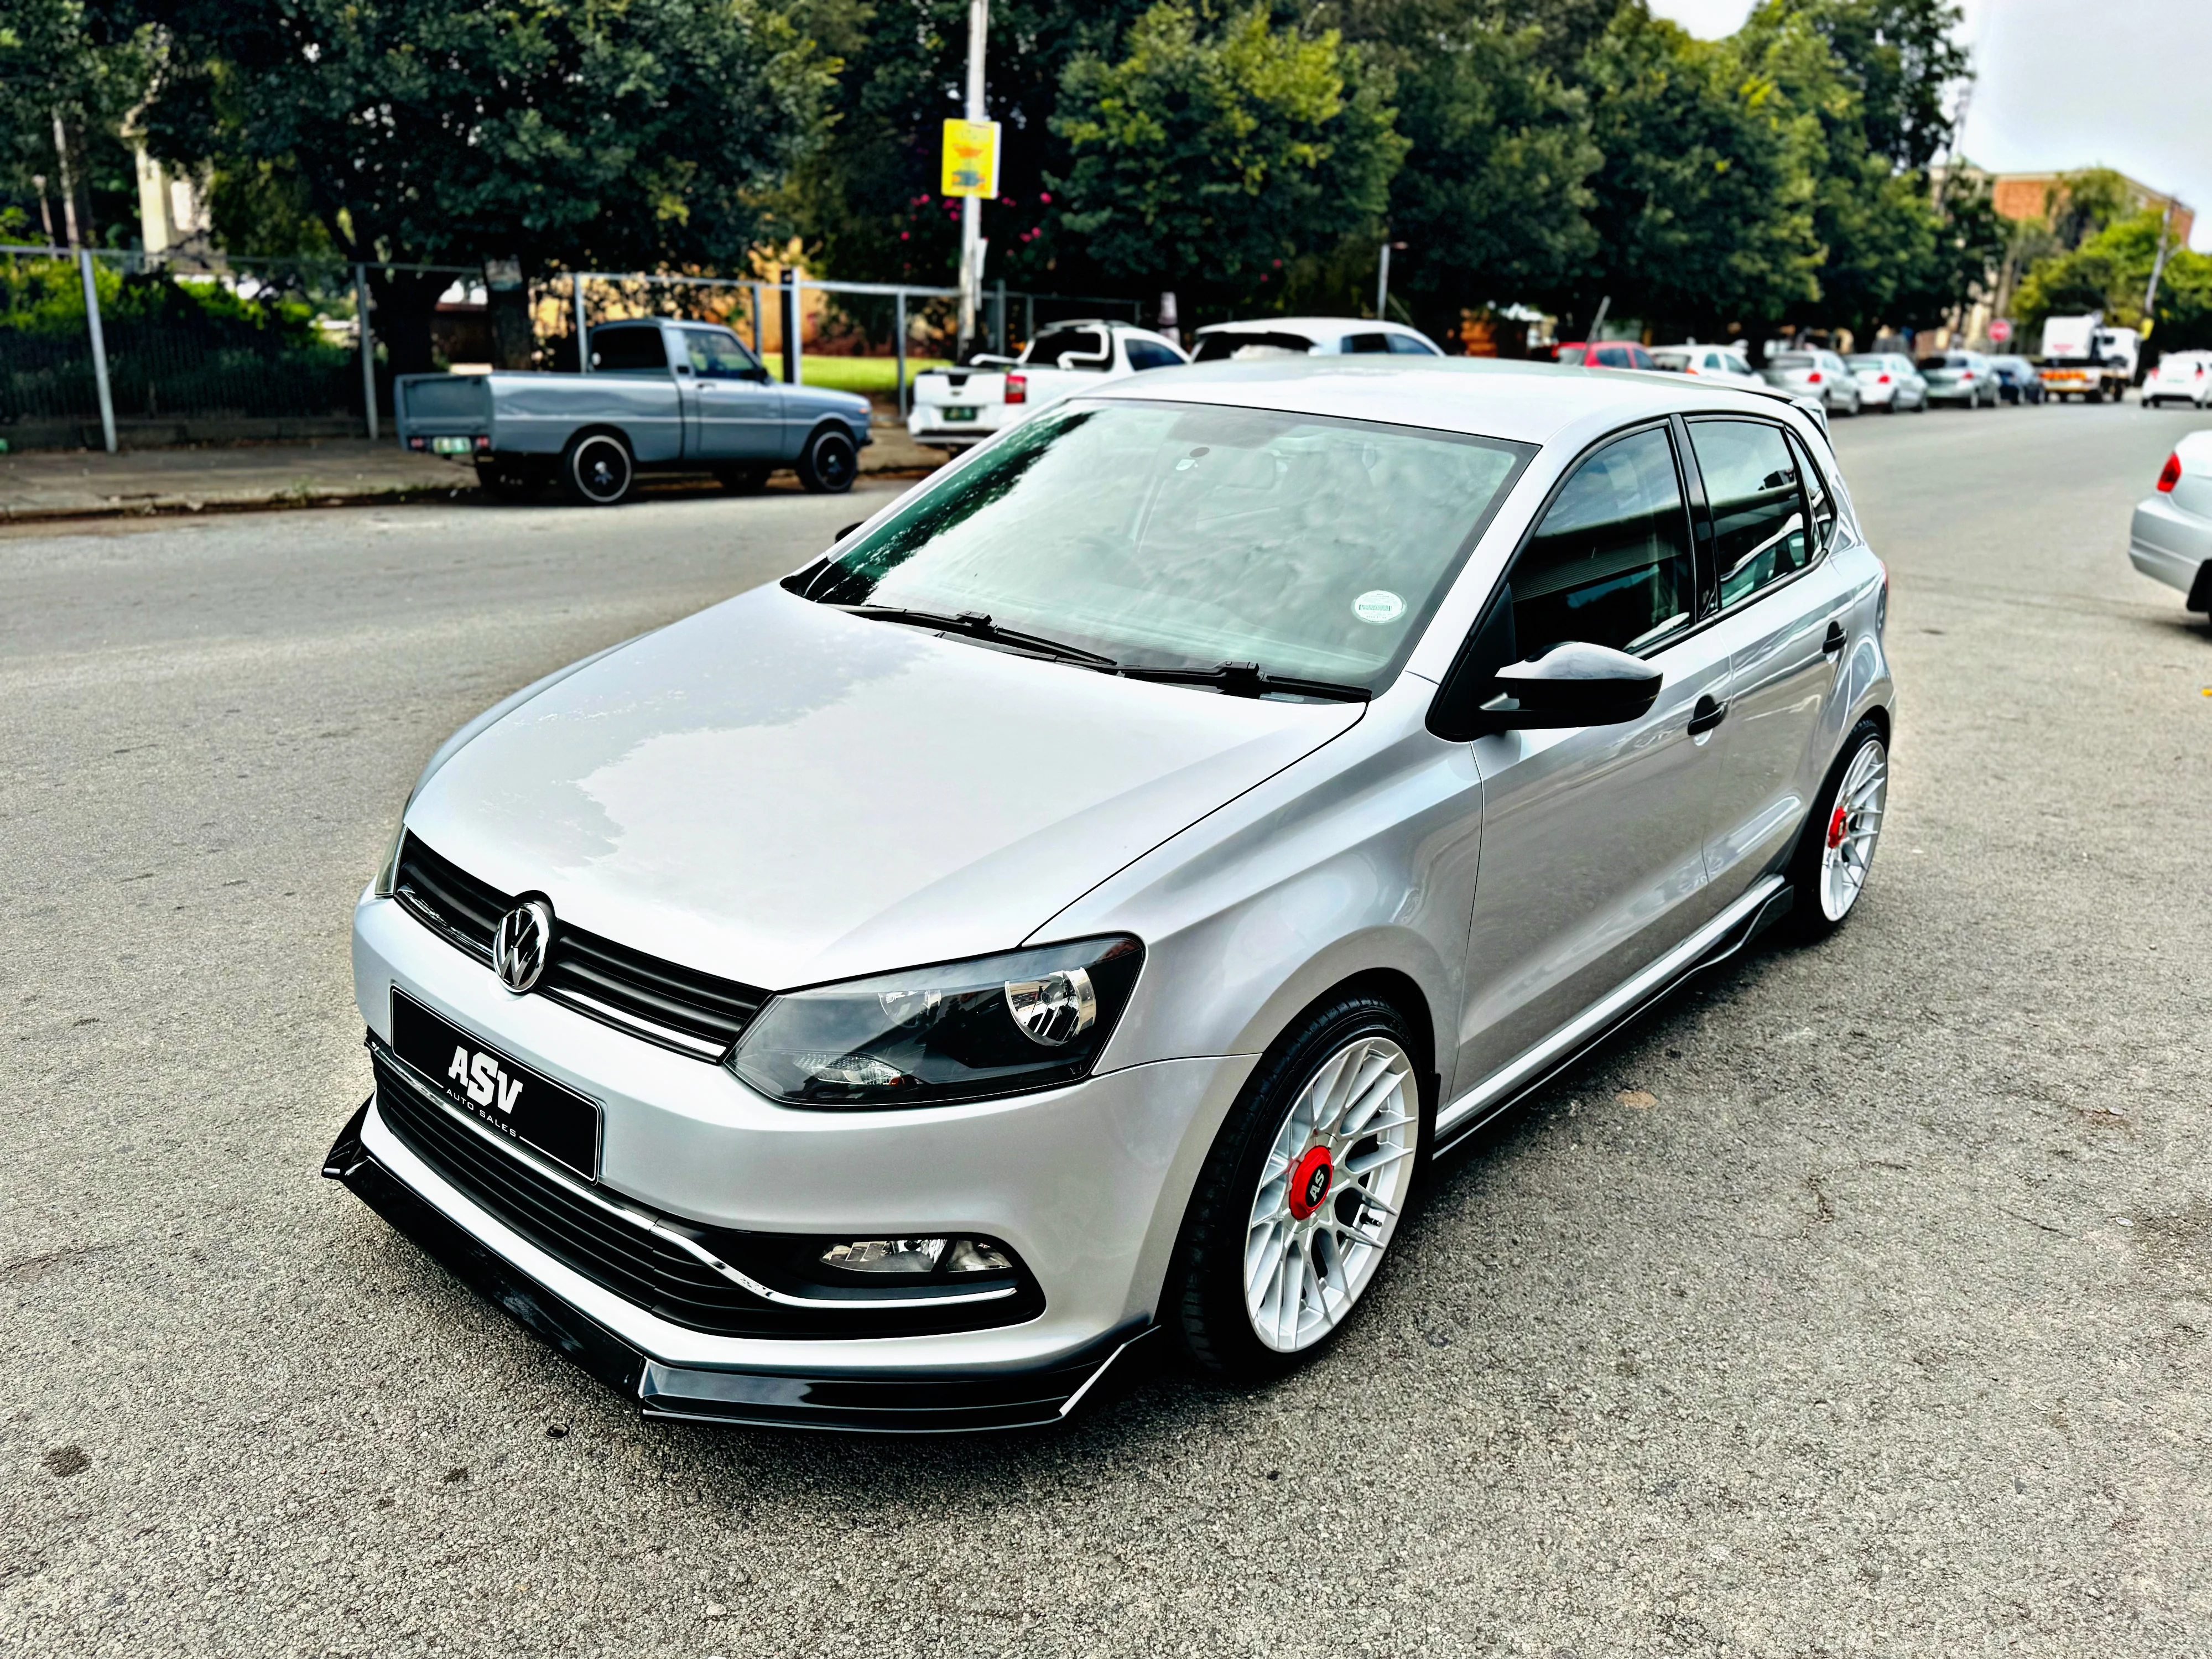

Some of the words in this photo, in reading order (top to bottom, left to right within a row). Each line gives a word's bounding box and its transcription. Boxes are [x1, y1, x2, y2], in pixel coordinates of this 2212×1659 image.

[495, 905, 547, 990] VW
[446, 1089, 474, 1111] AUTO
[479, 1109, 516, 1137] SALES
[448, 1045, 523, 1114] ASV
